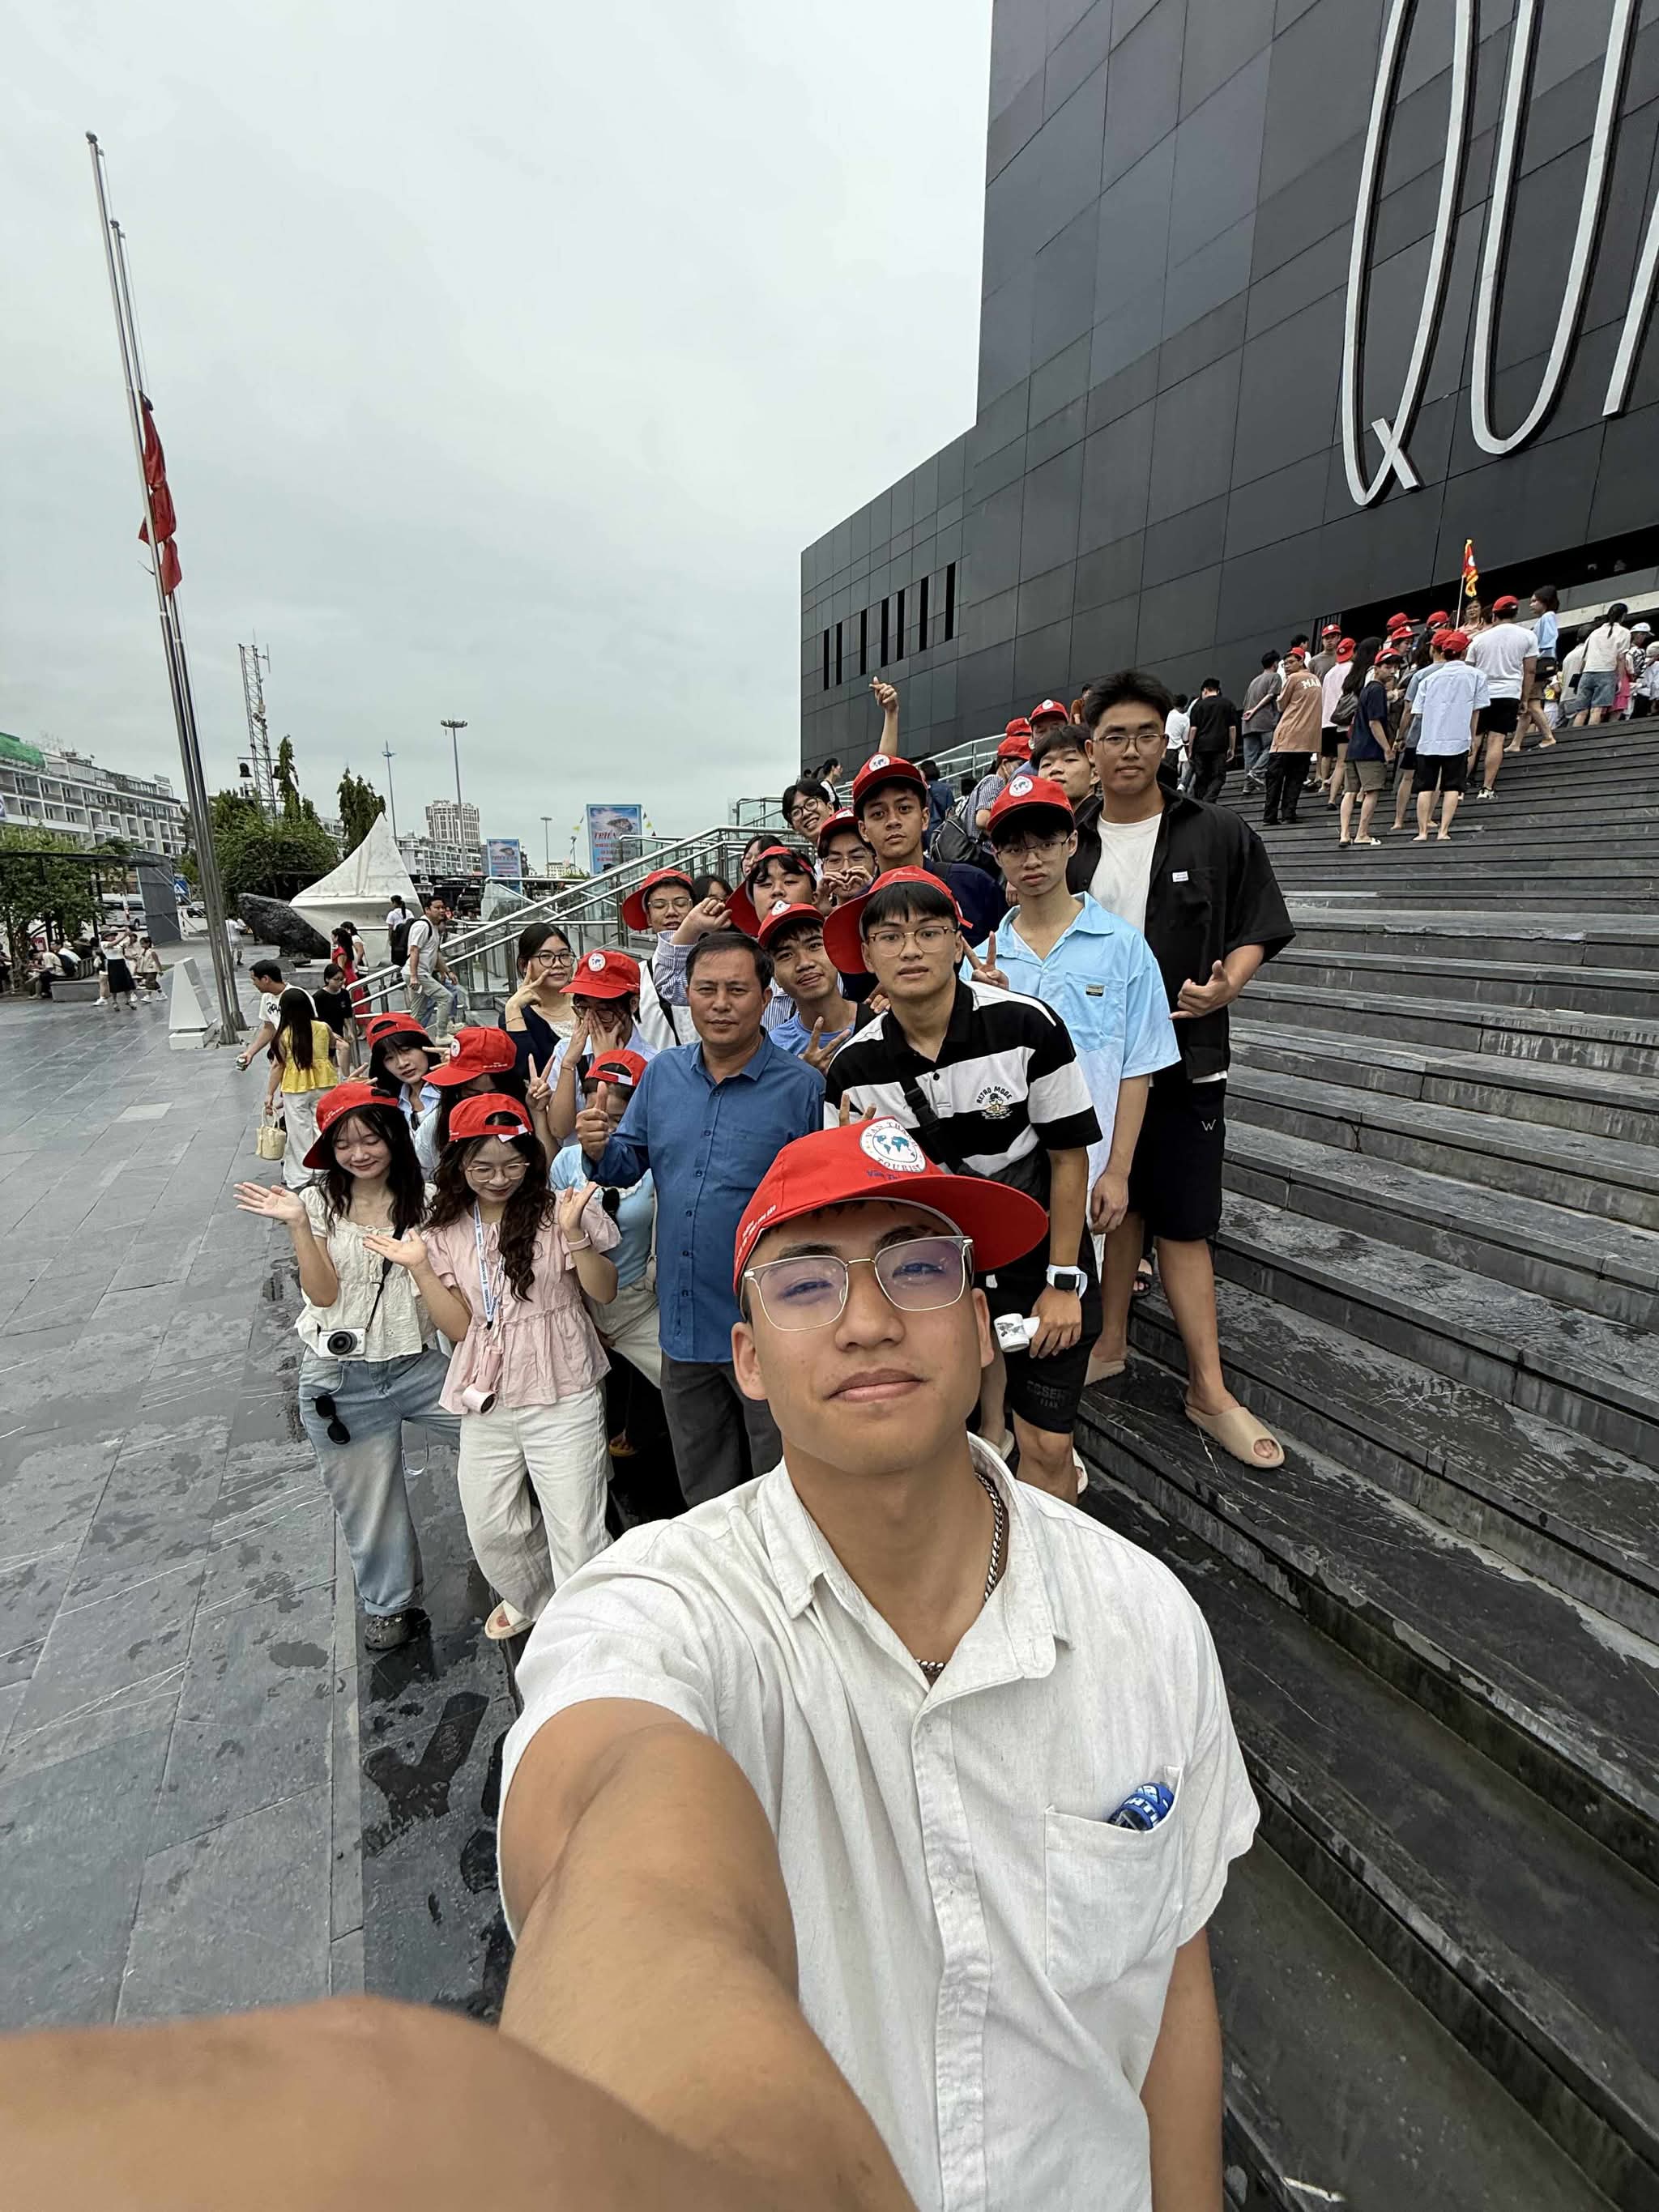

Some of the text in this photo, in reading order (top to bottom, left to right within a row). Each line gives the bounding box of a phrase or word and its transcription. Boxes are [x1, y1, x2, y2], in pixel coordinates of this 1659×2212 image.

[976, 1086, 1013, 1104] RETRO MODE
[877, 1157, 923, 1173] TOURIST
